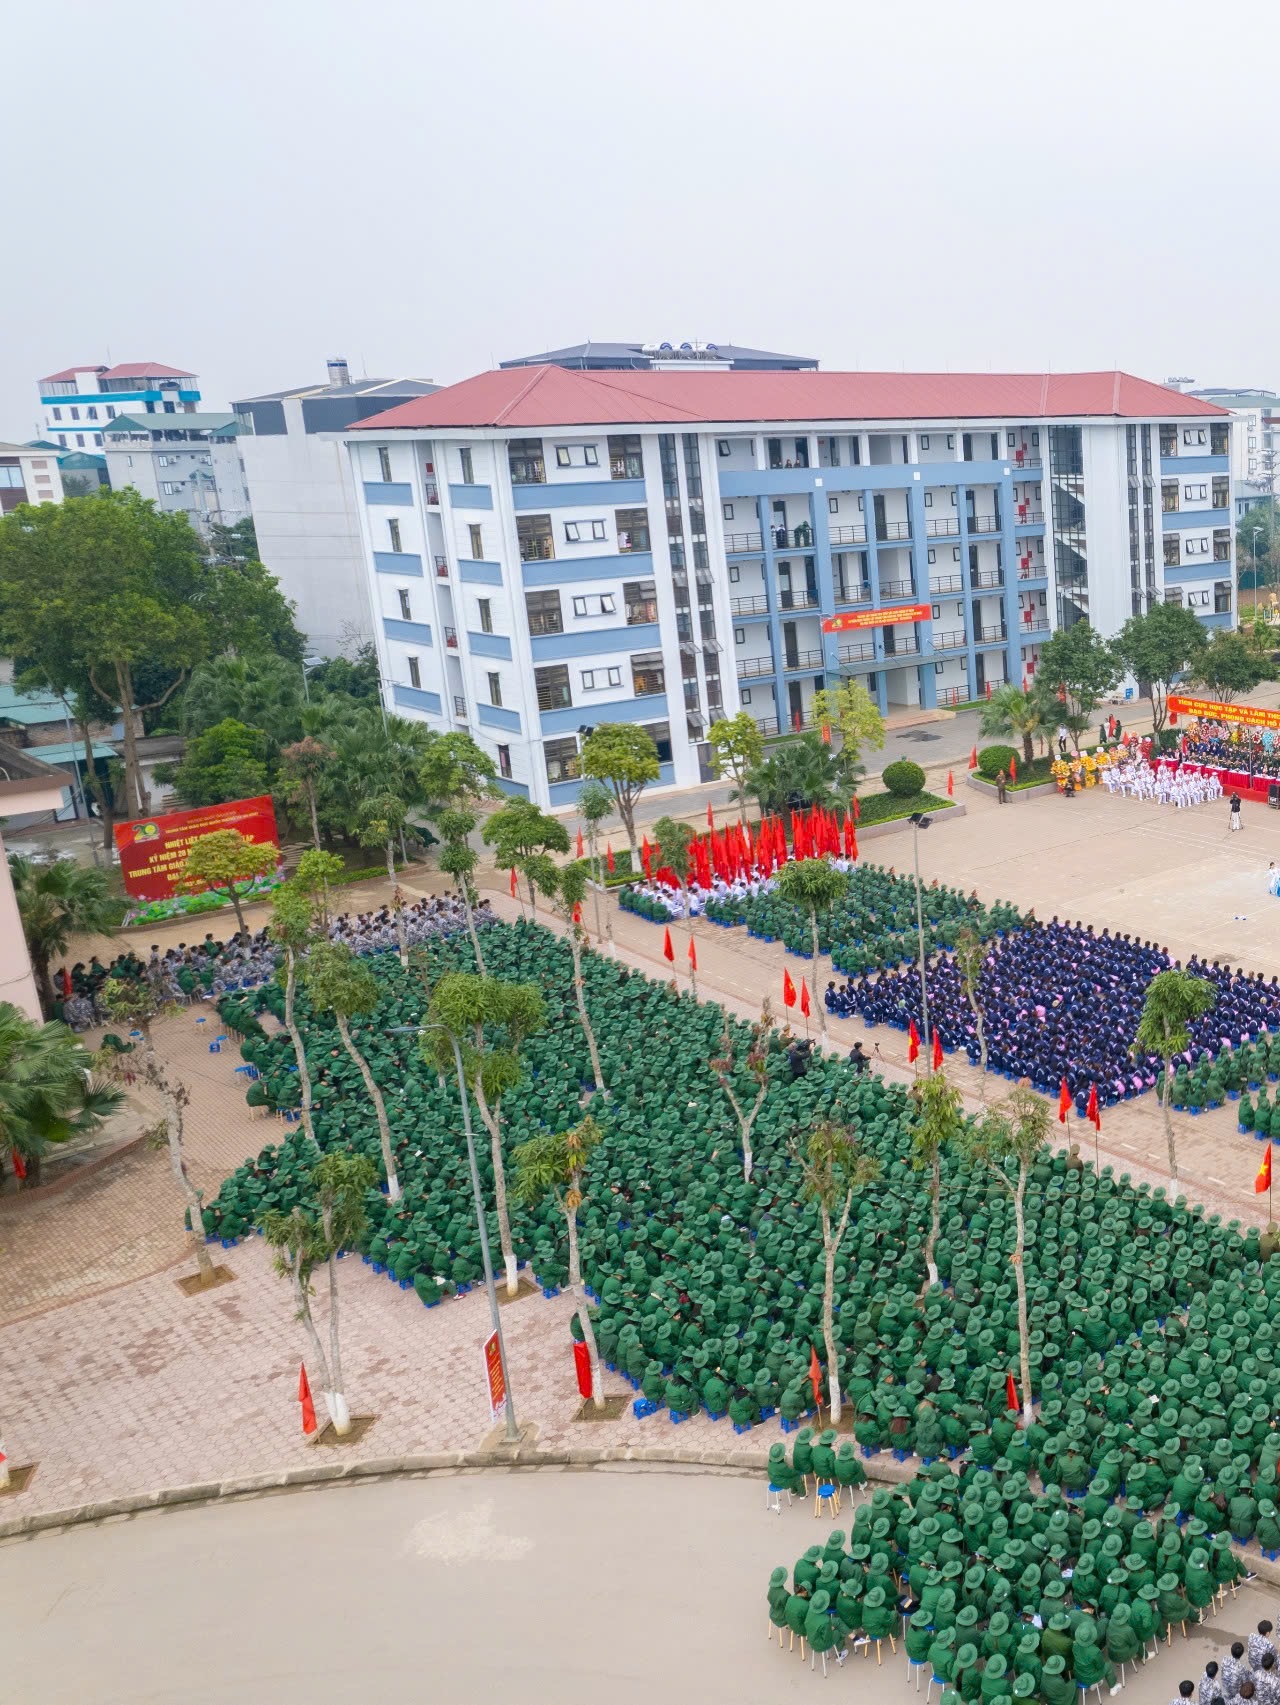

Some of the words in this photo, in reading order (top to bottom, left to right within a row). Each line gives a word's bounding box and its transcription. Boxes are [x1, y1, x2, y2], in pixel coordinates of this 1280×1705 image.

[1220, 713, 1245, 722] PHONG
[128, 867, 151, 879] TRUNG
[152, 863, 168, 873] TÂM
